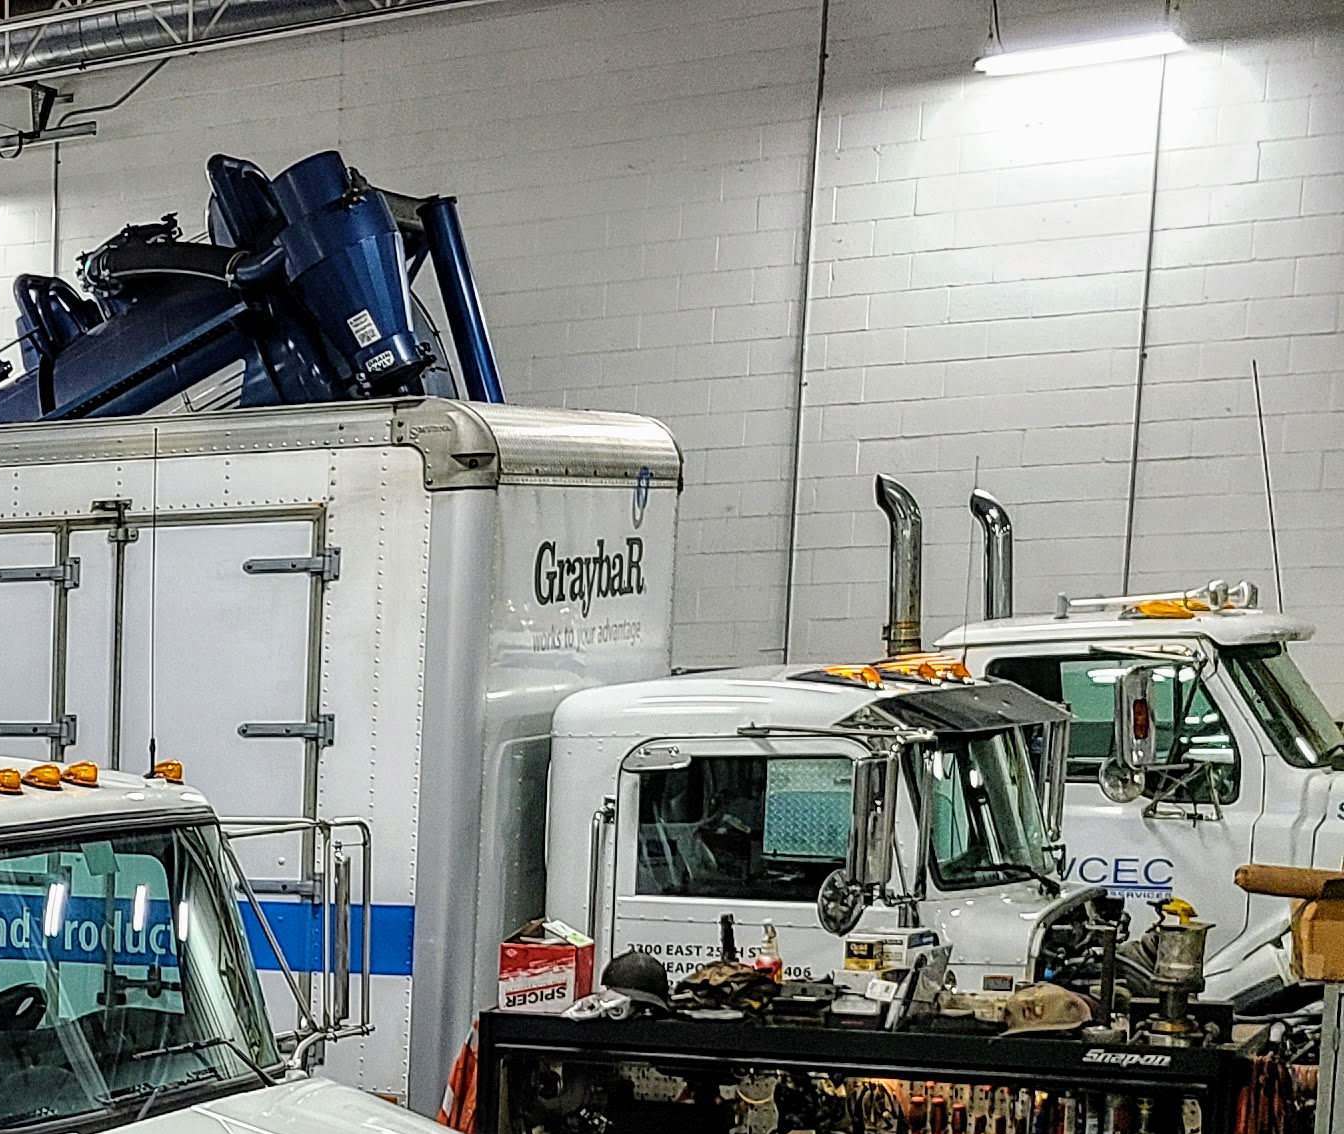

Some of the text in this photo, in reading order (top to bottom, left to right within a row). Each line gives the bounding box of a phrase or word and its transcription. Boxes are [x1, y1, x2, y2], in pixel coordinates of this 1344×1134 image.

[666, 944, 703, 956] EAST
[706, 946, 744, 958] 25H
[505, 986, 568, 1008] SPICER
[1082, 1049, 1172, 1068] Snap-on
